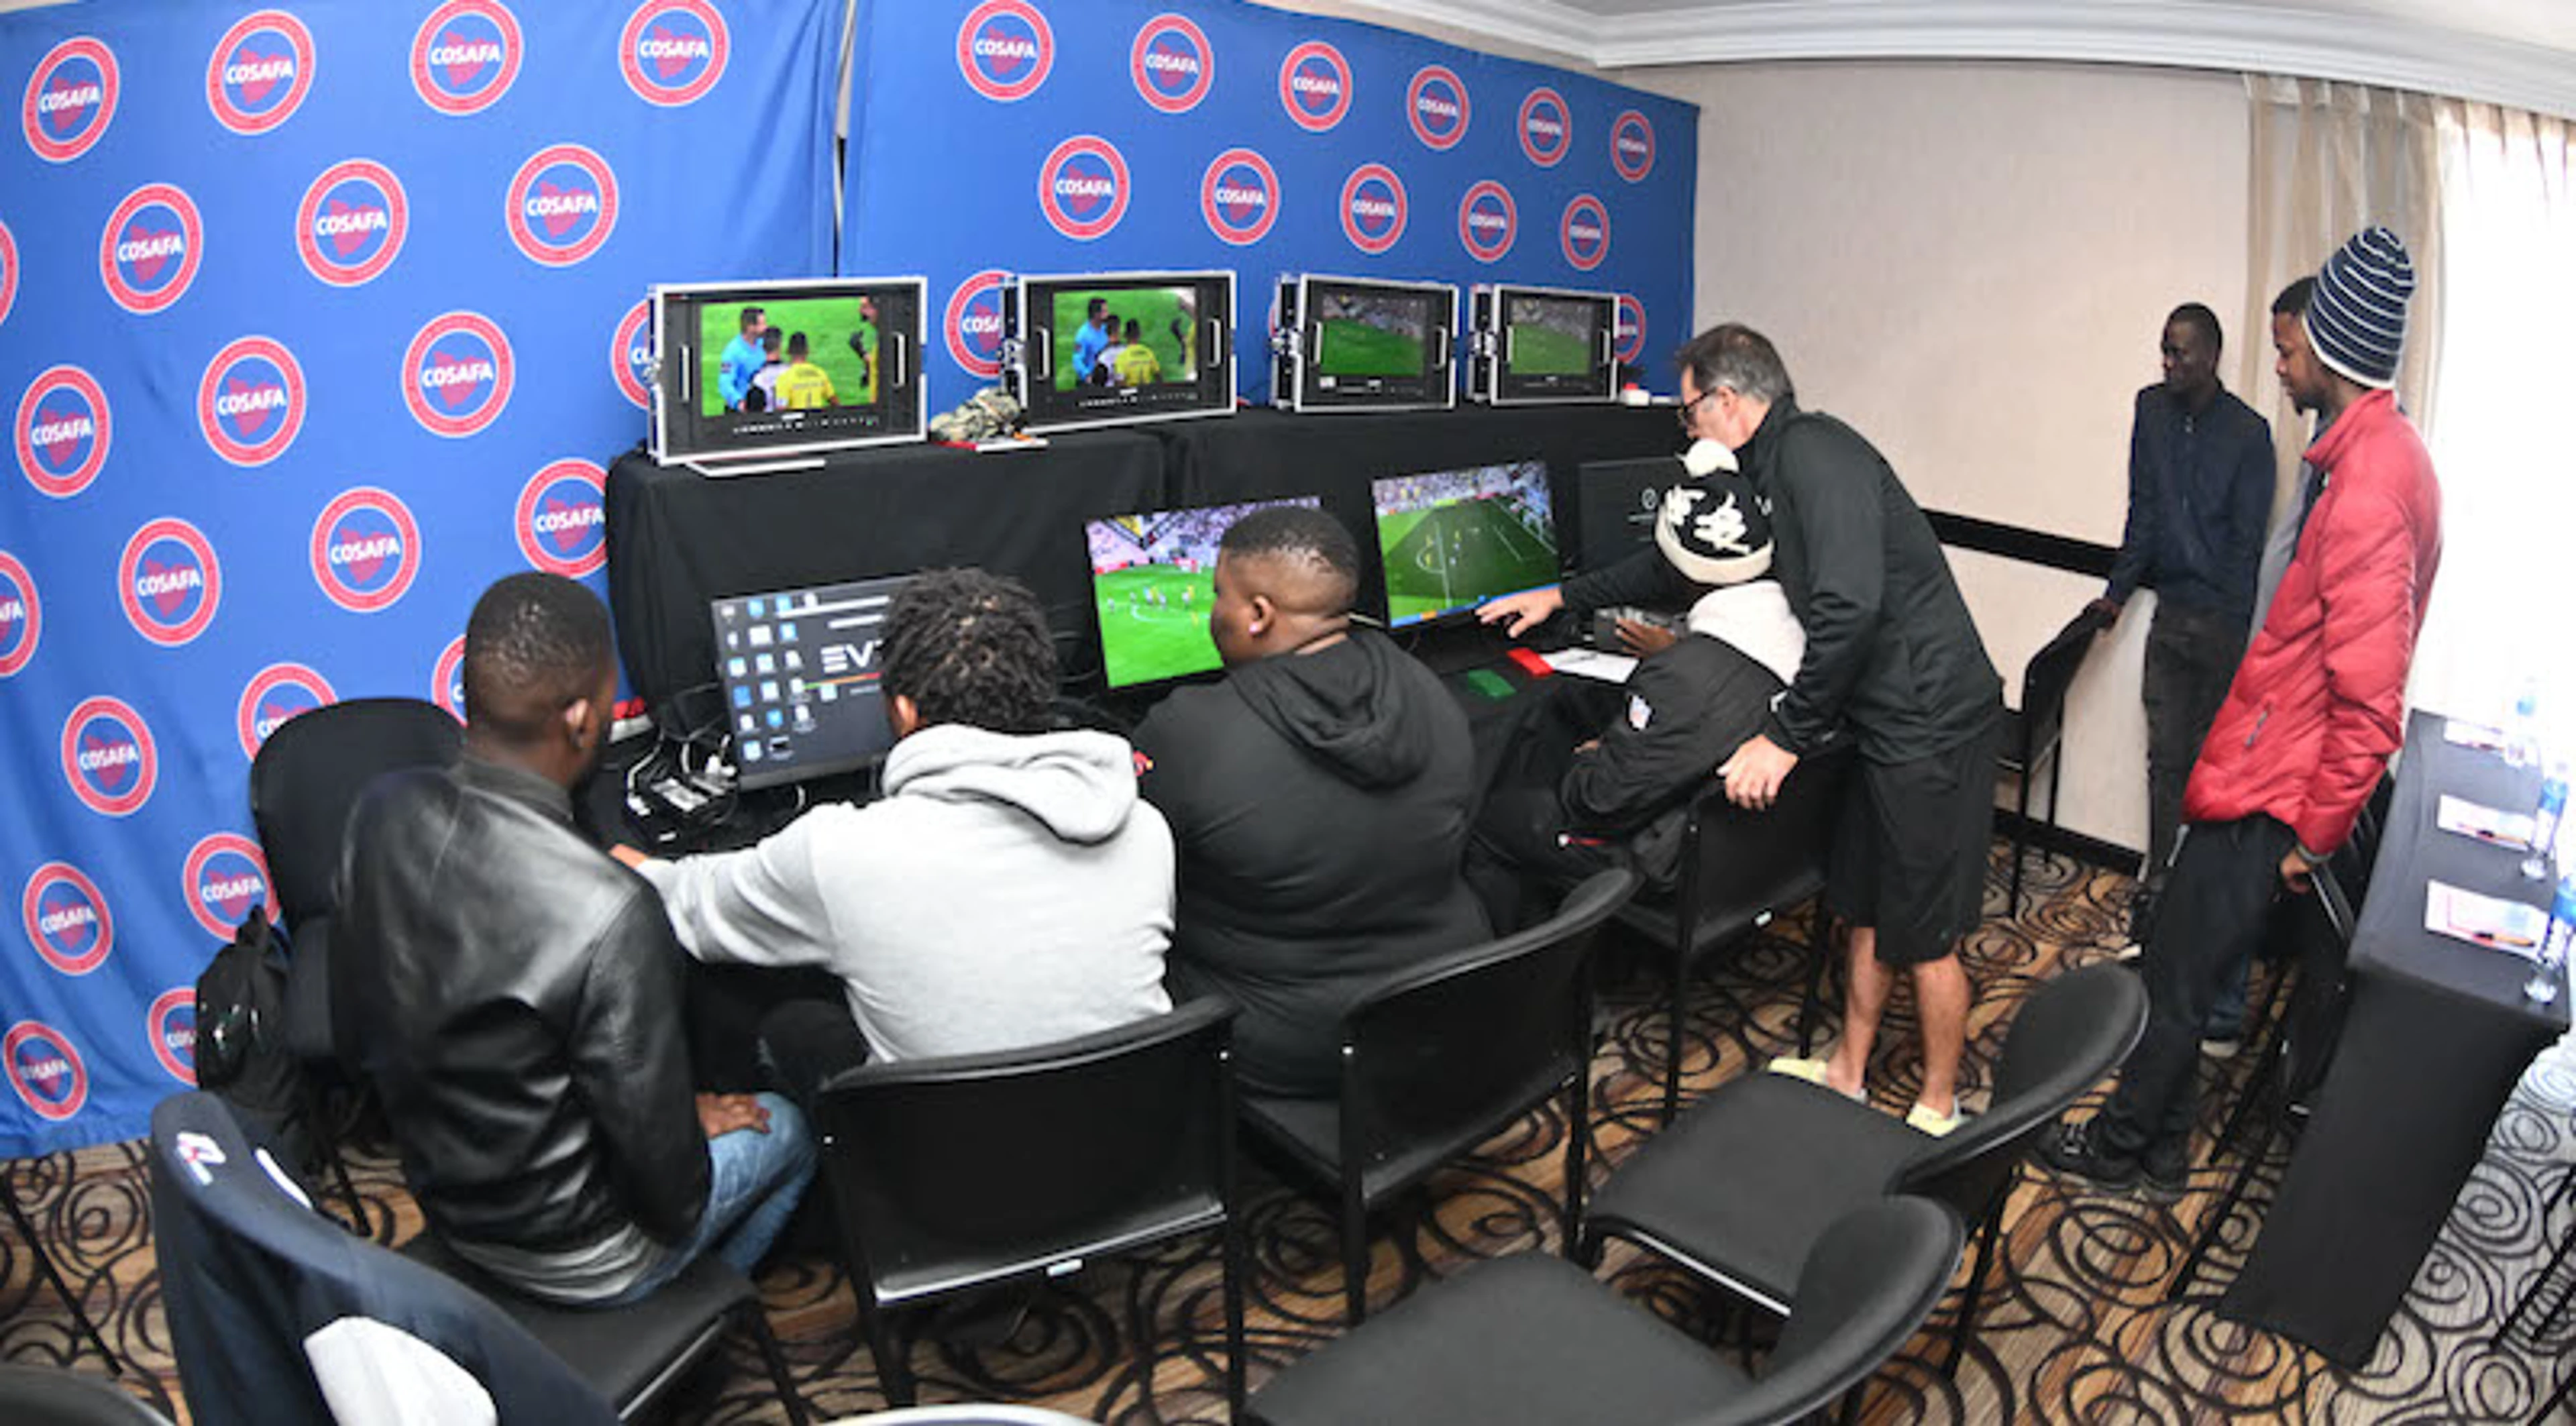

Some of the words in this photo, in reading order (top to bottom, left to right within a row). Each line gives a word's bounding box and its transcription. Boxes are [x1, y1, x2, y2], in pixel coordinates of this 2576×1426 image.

[431, 44, 502, 65] COSAFA
[639, 40, 709, 58] COSAFA
[975, 38, 1036, 58] COSAFA
[225, 61, 294, 85] COSAFA
[1145, 54, 1199, 74] COSAFA
[1292, 76, 1340, 95] COSAFA
[39, 87, 101, 113] COSAFA
[1417, 98, 1459, 117] COSAFA
[1055, 178, 1113, 196] COSAFA
[1215, 186, 1266, 205] COSAFA
[525, 195, 597, 217] COSAFA
[316, 214, 387, 236] COSAFA
[118, 235, 183, 262] COSAFA
[421, 362, 494, 386] COSAFA
[217, 389, 286, 415] COSAFA
[31, 419, 93, 445] COSAFA
[536, 506, 605, 532] COSAFA
[330, 538, 400, 563] COSAFA
[137, 570, 202, 597] COSAFA
[820, 639, 884, 673] EV
[79, 744, 138, 770] COSAFA
[202, 877, 262, 902] COSAFA
[40, 908, 96, 935] COSAFA
